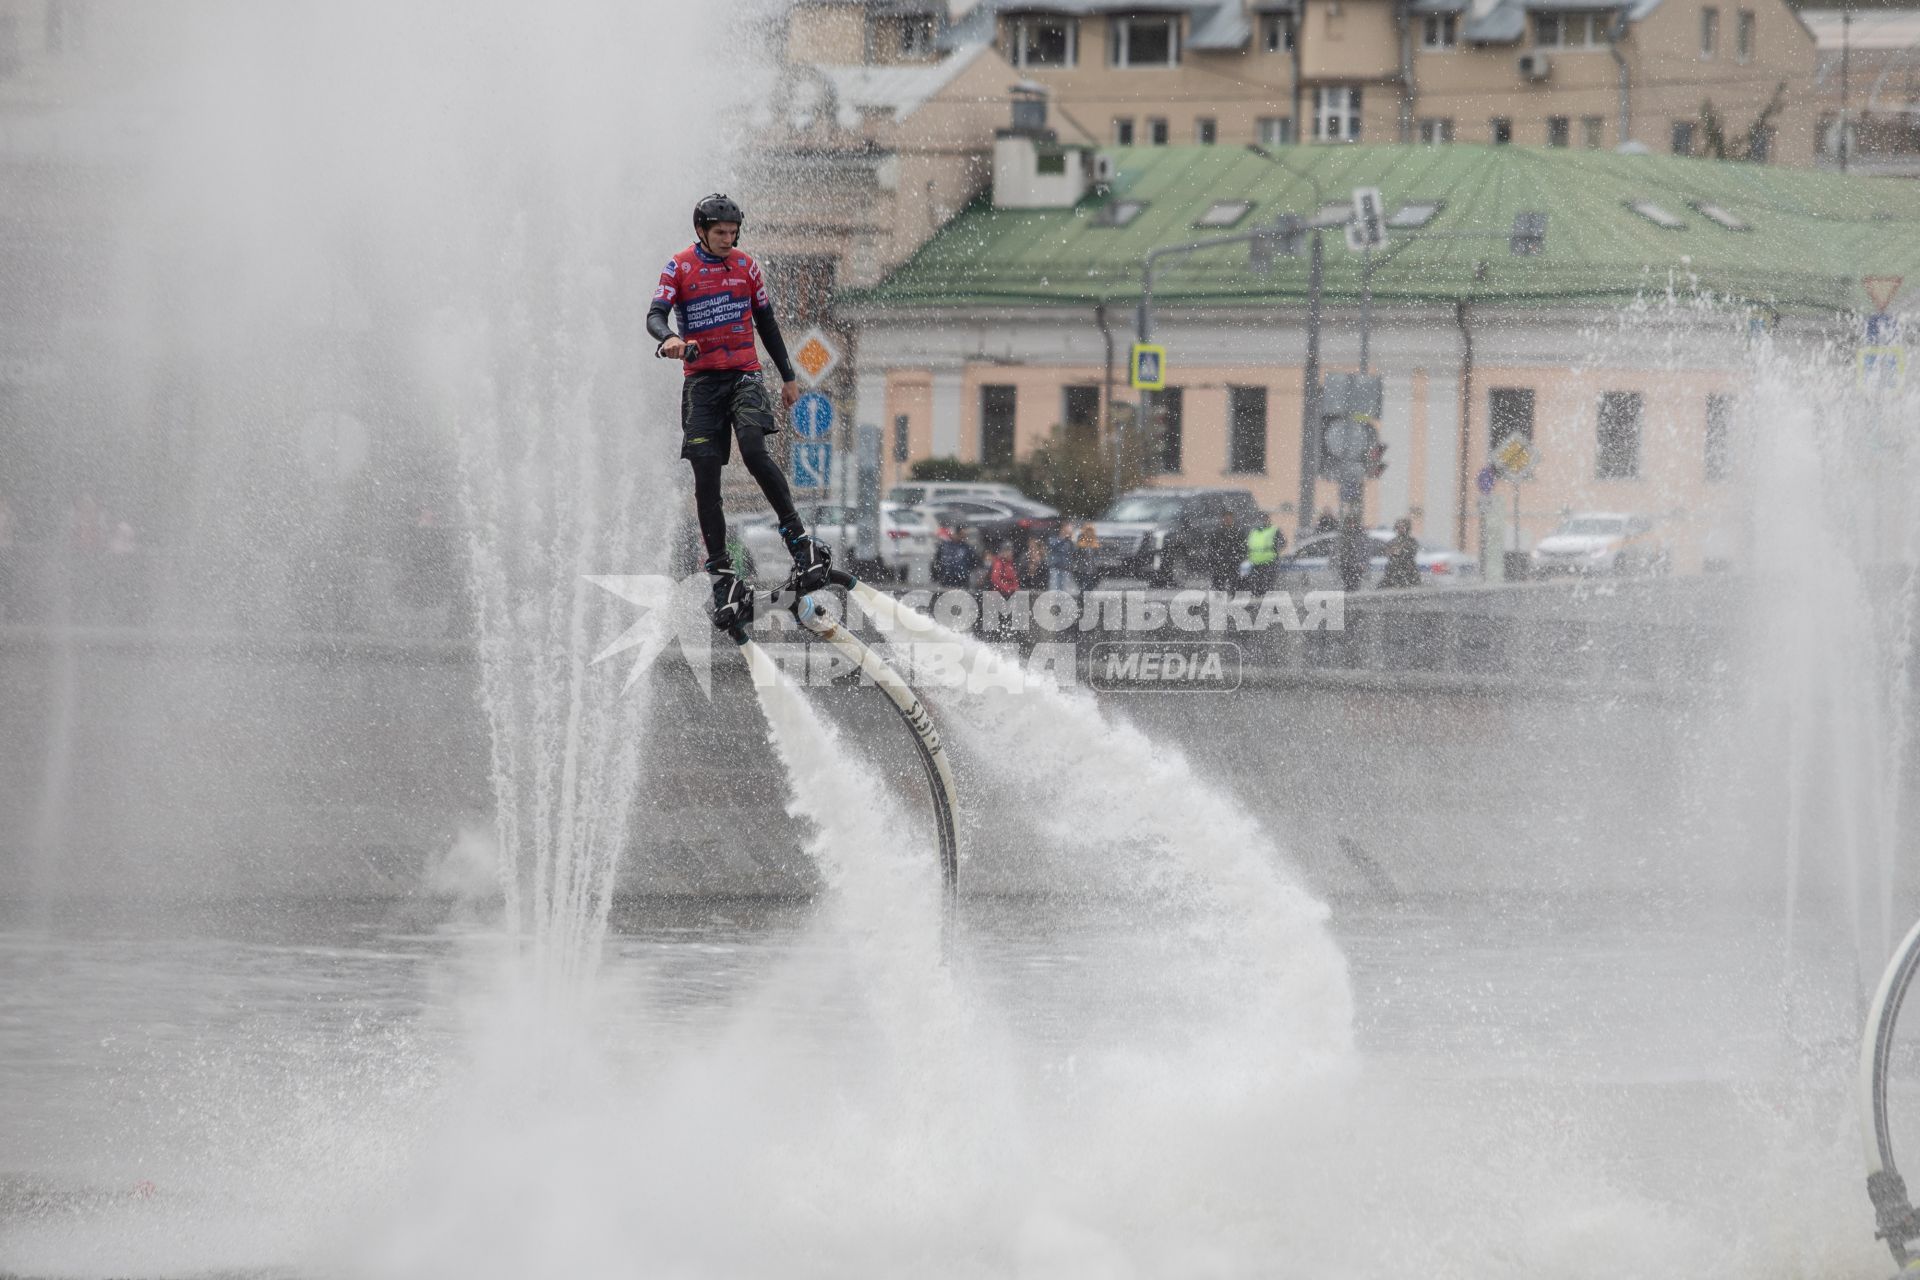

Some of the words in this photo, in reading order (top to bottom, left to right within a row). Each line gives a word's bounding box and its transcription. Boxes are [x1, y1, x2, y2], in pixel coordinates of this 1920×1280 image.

[687, 295, 729, 312] ФЕДЕРАЦИЯ
[688, 318, 714, 330] СПОРТА
[714, 311, 741, 324] РОССИИ
